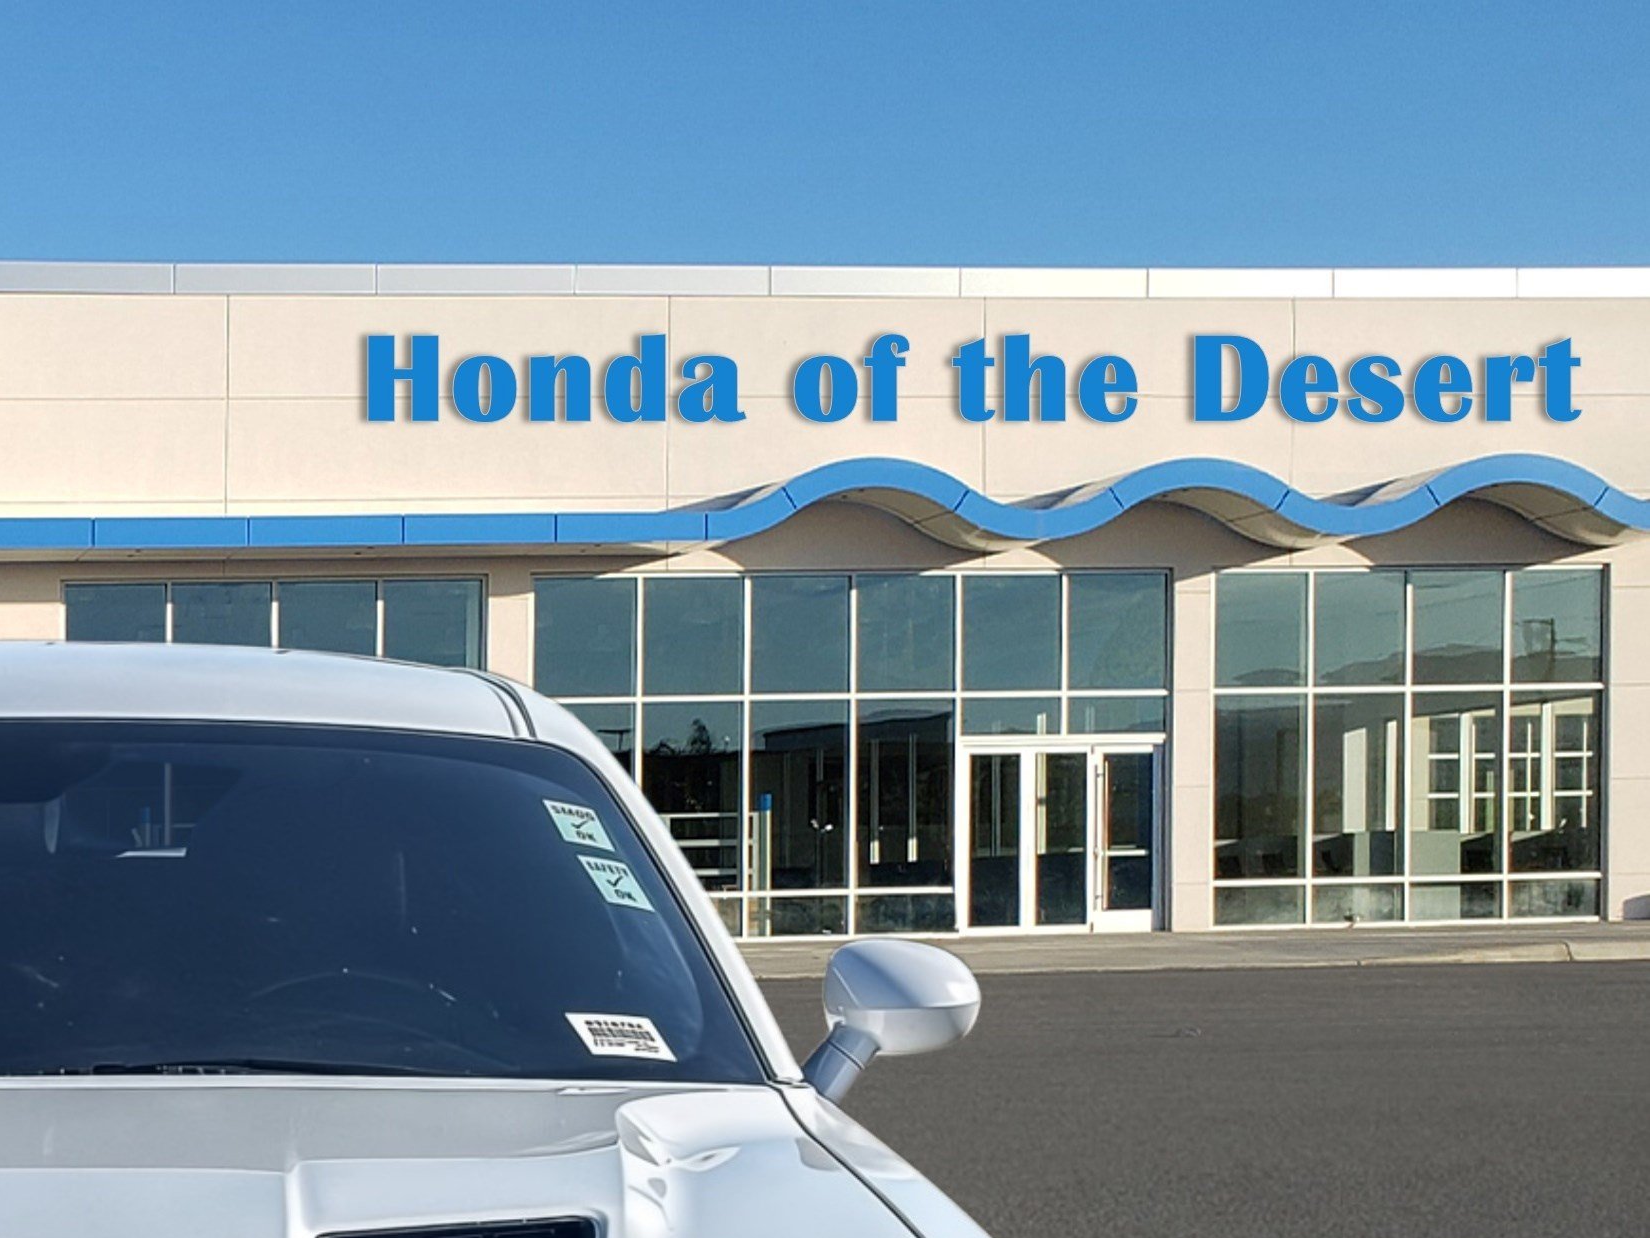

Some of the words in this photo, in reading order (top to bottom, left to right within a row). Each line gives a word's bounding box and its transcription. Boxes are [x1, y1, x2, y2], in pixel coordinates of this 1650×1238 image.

[366, 333, 748, 423] Honda
[793, 333, 911, 423] of
[951, 333, 1138, 423] the
[1193, 334, 1583, 423] Desert
